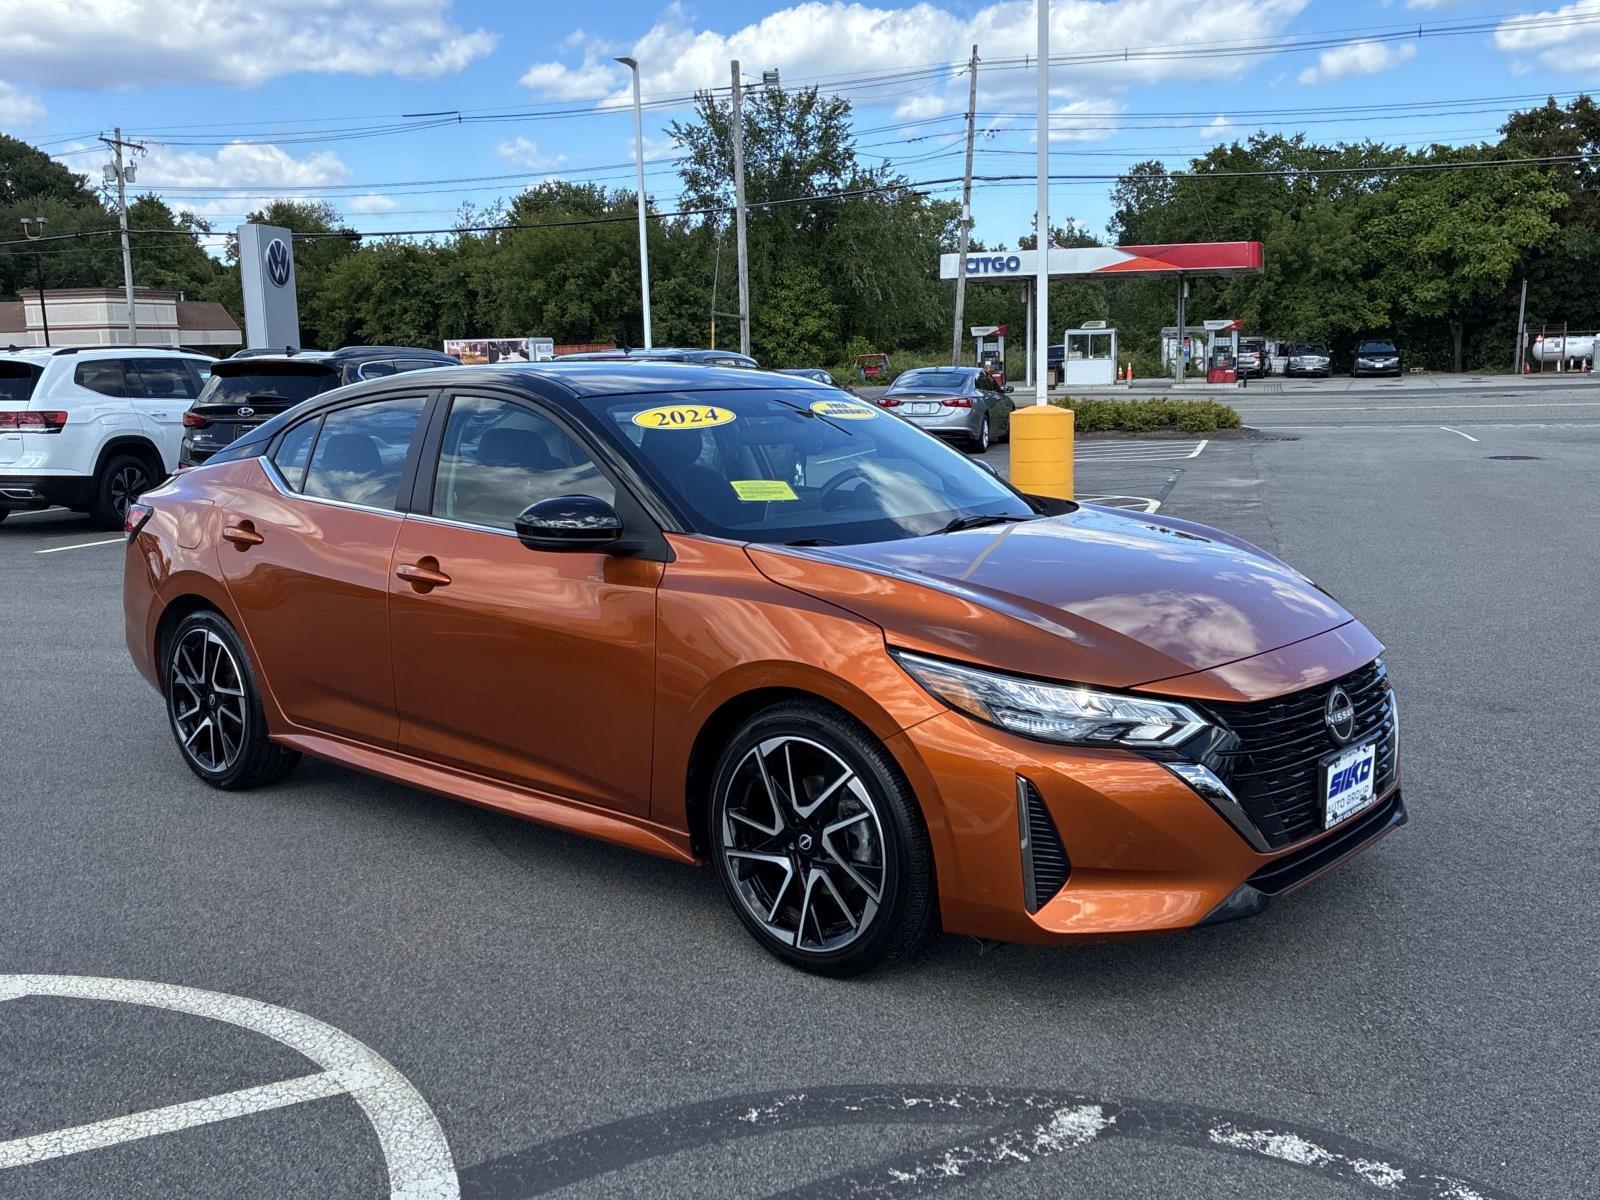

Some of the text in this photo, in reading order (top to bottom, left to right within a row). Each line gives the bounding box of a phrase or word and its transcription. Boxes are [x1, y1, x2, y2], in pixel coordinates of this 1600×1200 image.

[966, 255, 1020, 273] CITGO
[652, 408, 719, 426] 2024
[1328, 756, 1373, 799] SILKO
